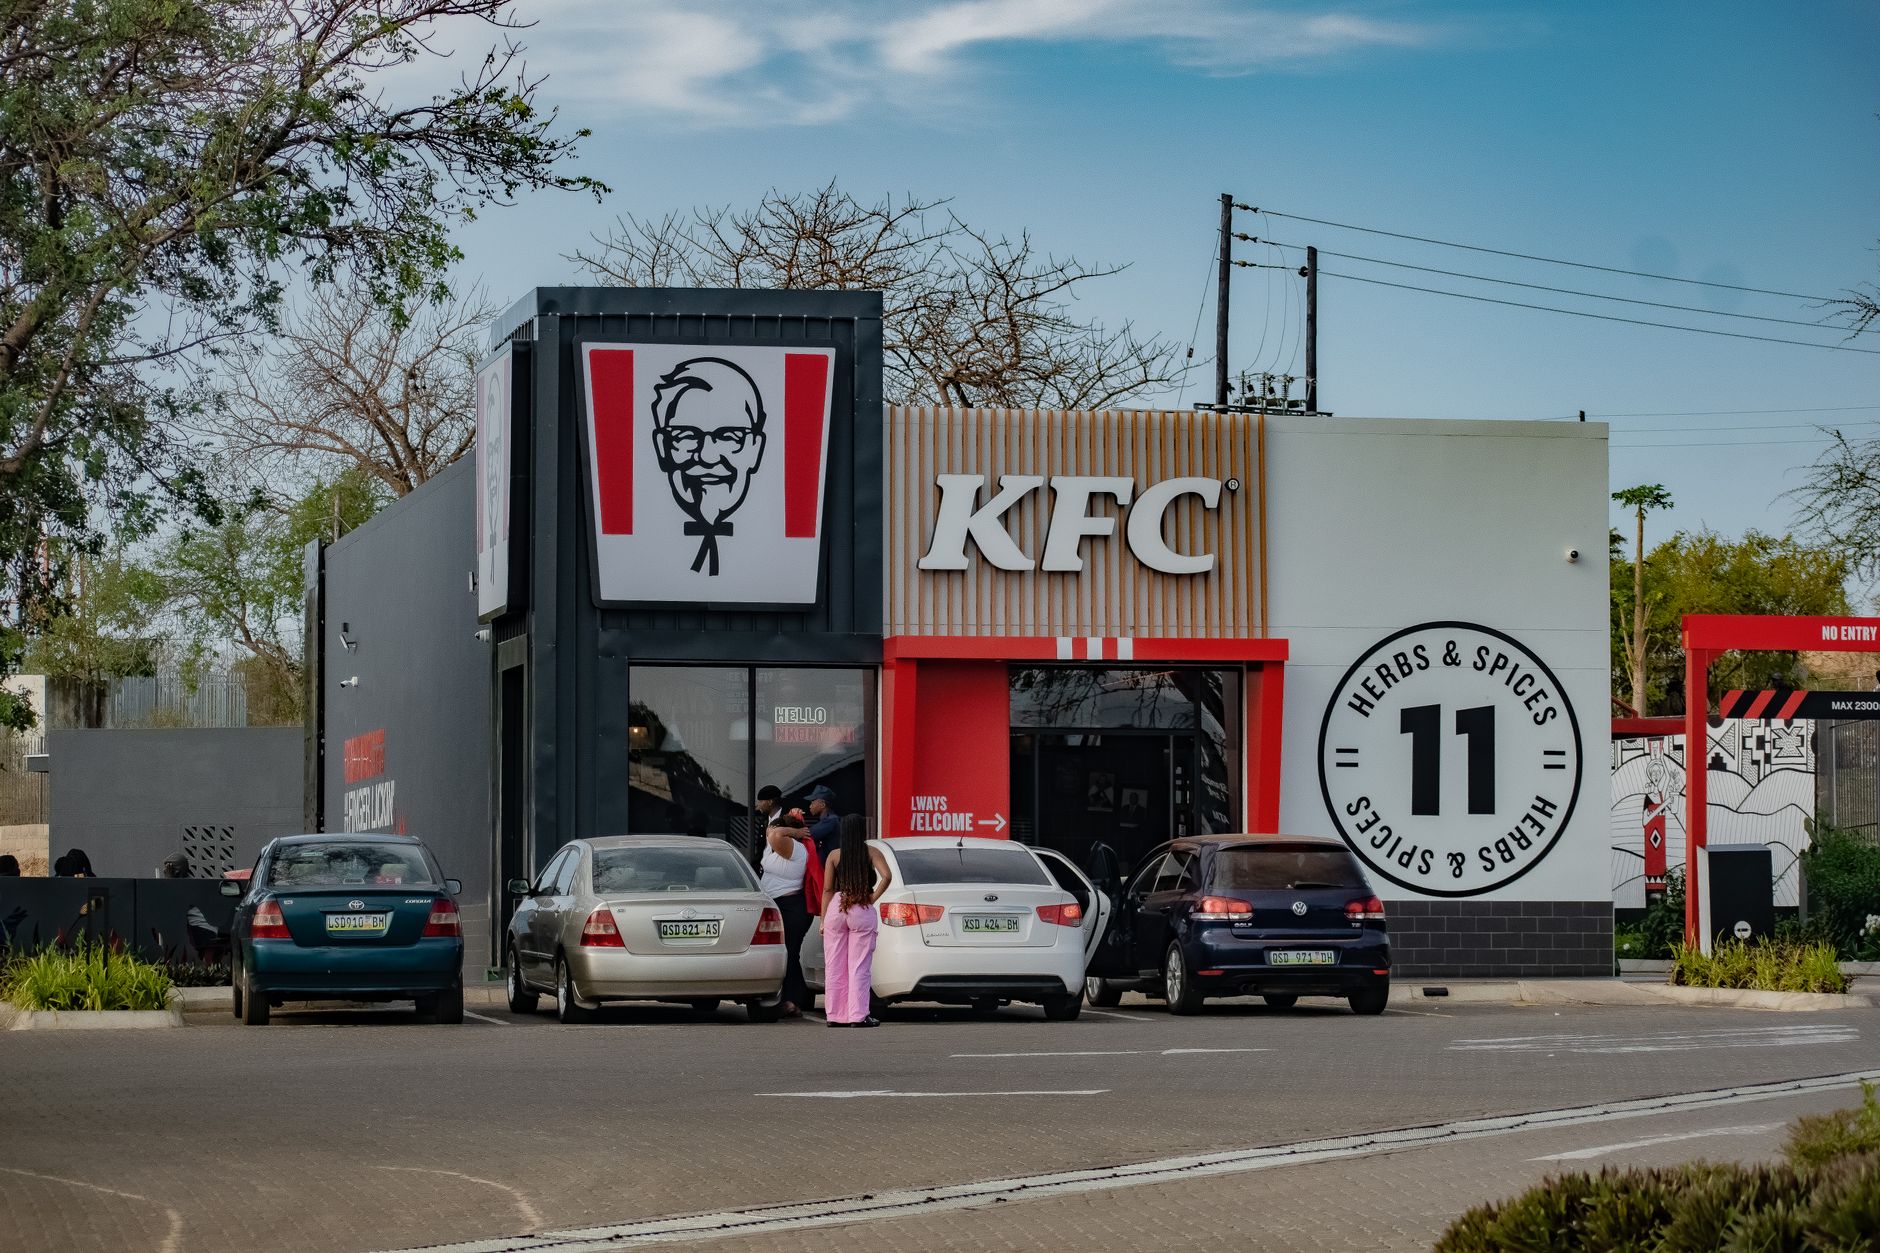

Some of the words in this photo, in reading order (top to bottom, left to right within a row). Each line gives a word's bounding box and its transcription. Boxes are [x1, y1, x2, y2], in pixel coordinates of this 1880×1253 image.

[918, 474, 1221, 574] KFC
[1822, 625, 1838, 641] NO
[1841, 626, 1877, 641] ENTRY
[1347, 645, 1430, 718] HERBS
[1442, 640, 1461, 667] &
[1473, 646, 1557, 726] SPICES
[1831, 701, 1853, 711] MAX
[1854, 701, 1880, 711] 2300
[774, 707, 826, 724] HELLO
[1400, 704, 1495, 816] 11
[911, 796, 947, 811] LWAYS
[1346, 796, 1435, 875] SPICES
[1478, 795, 1557, 872] HERBS
[1446, 852, 1466, 878] &
[662, 924, 680, 936] QSD
[682, 924, 700, 936] 821
[705, 923, 718, 935] AS
[964, 919, 980, 930] XSD
[984, 919, 1000, 930] 424
[1272, 952, 1289, 964] QSD
[1295, 952, 1313, 963] 971
